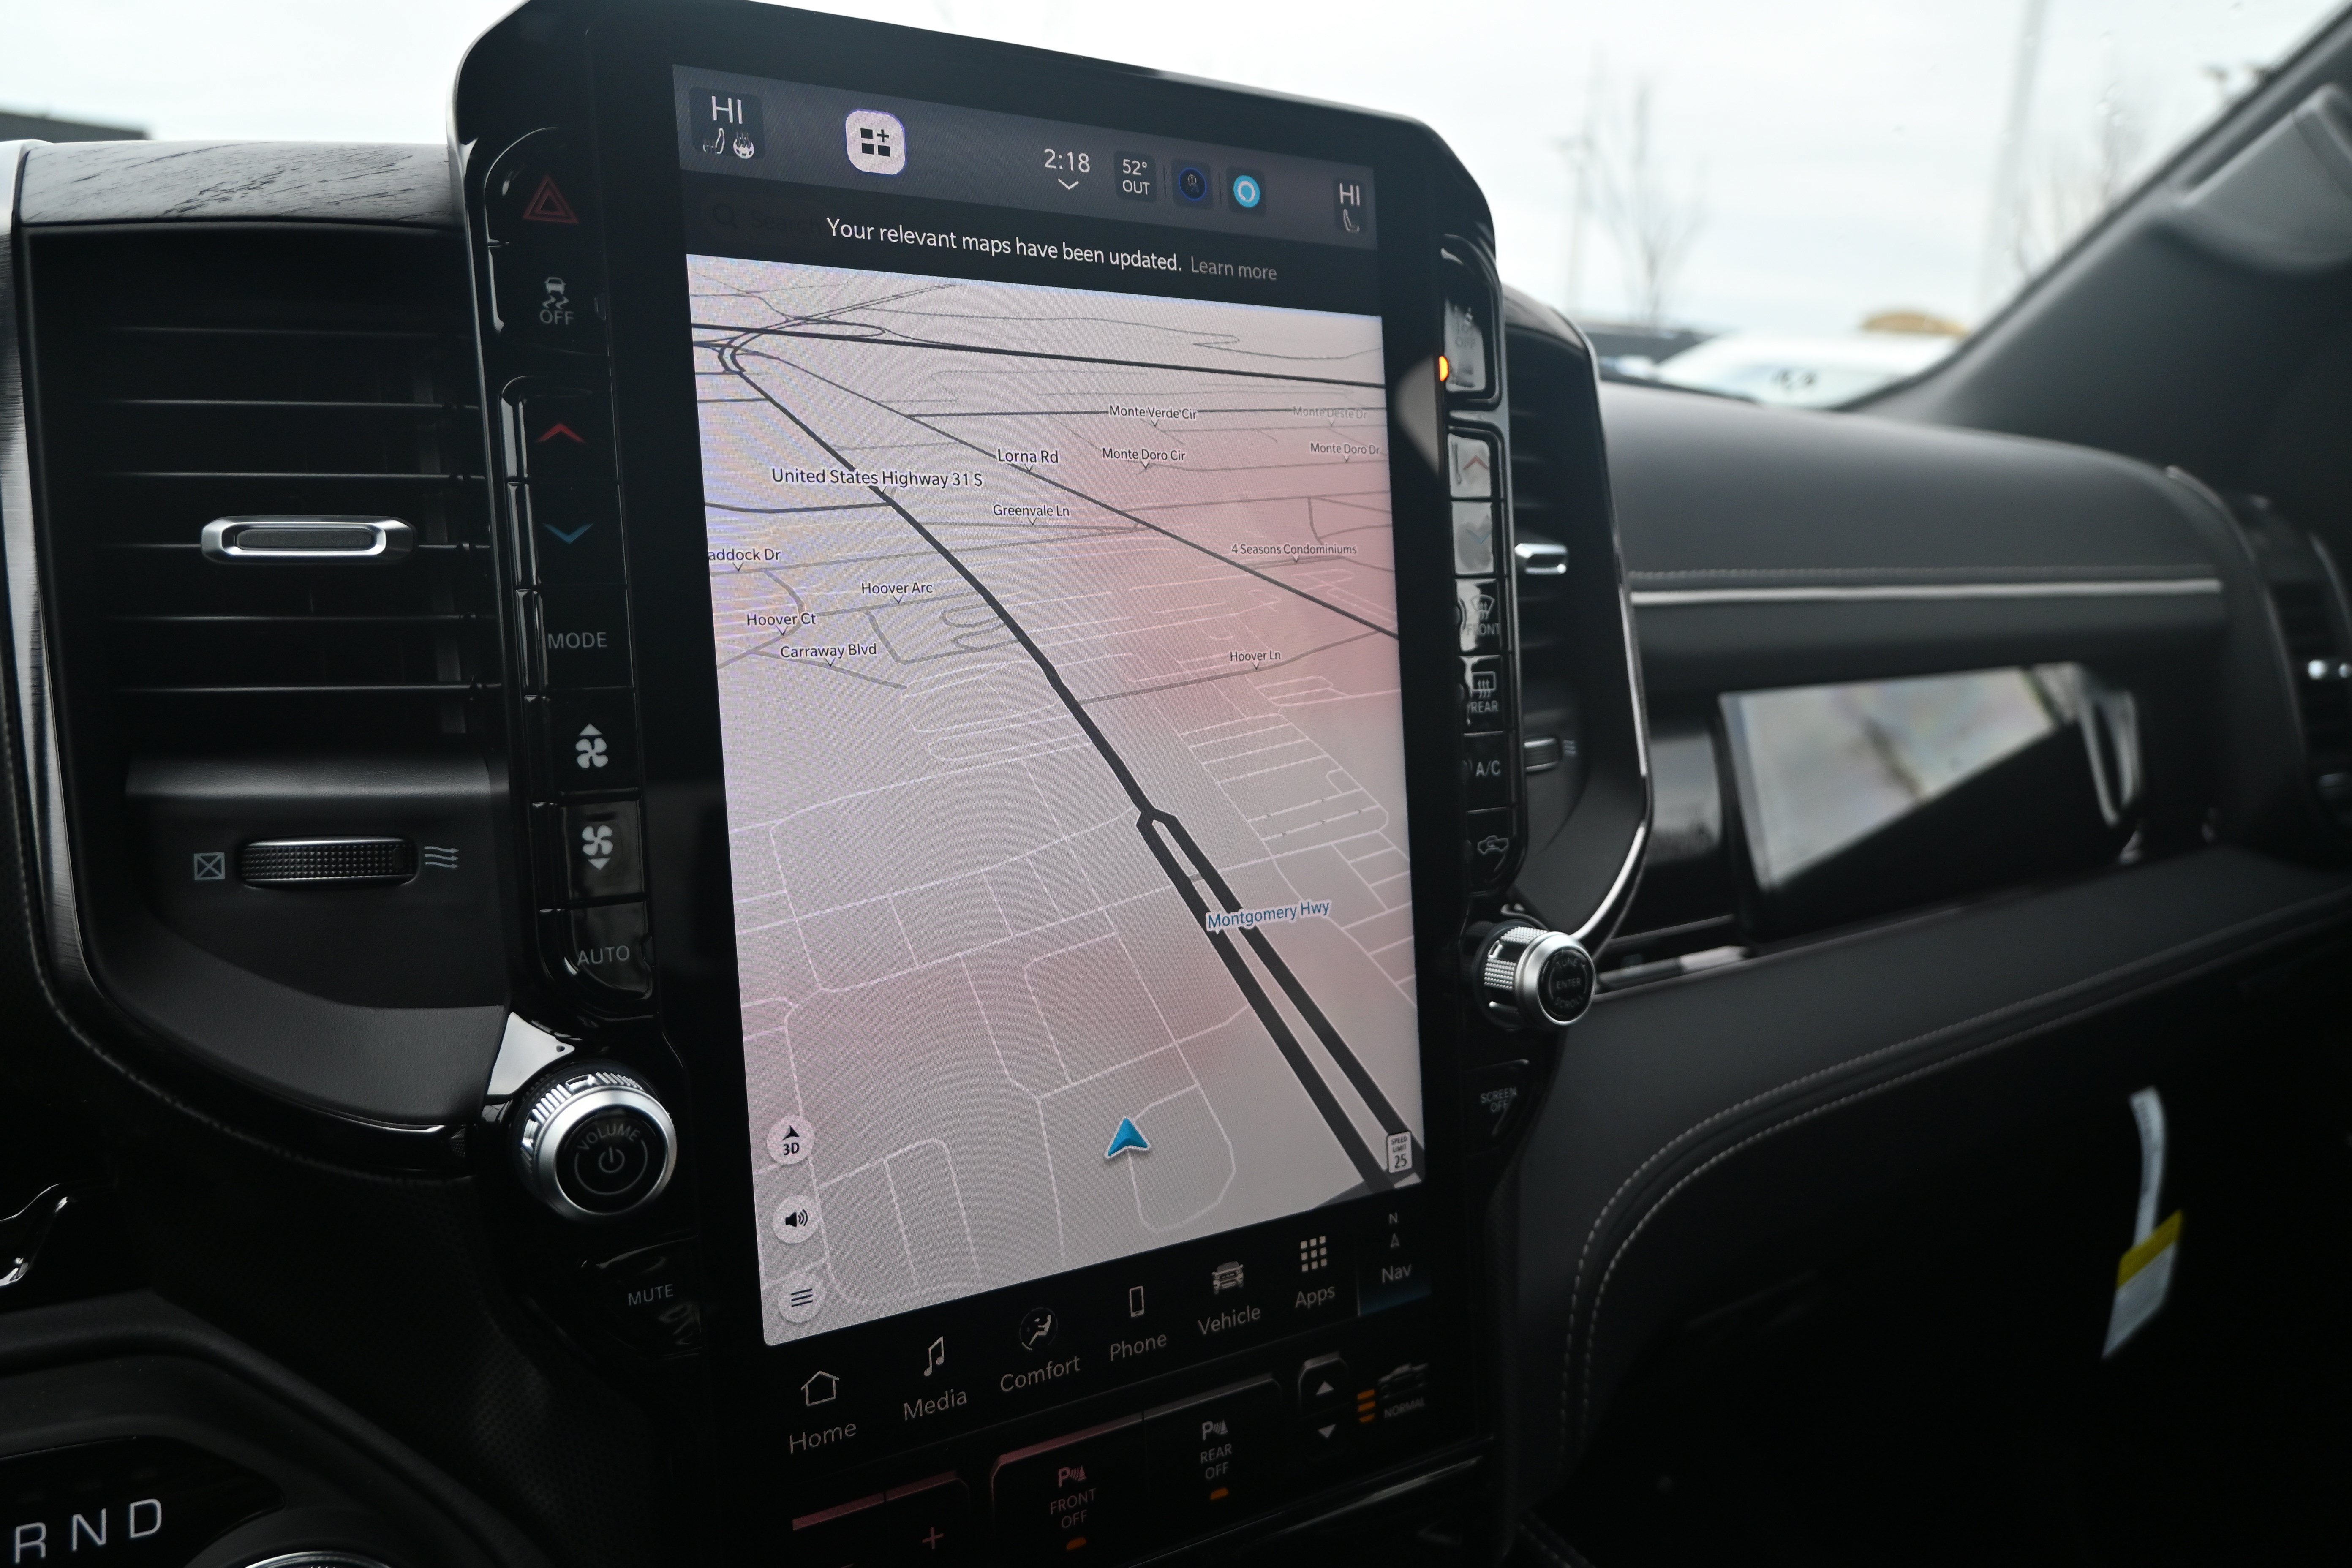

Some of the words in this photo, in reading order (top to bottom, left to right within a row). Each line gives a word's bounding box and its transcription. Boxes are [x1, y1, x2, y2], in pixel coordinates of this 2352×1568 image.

[712, 96, 743, 123] HI
[1044, 148, 1090, 173] 2:18
[1122, 180, 1150, 195] OUT
[1339, 183, 1360, 206] HI
[827, 217, 874, 240] Your
[880, 225, 956, 248] relevant
[962, 237, 1011, 257] maps
[1016, 237, 1057, 259] have
[1063, 242, 1104, 264] been
[1109, 250, 1182, 272] updated.
[1191, 256, 1233, 276] Learn
[1239, 266, 1277, 280] more
[540, 310, 574, 325] OFF
[1110, 405, 1145, 417] Monte
[1148, 407, 1179, 419] Verde
[1182, 408, 1198, 419] Cir
[1293, 406, 1324, 417] Monte
[1356, 409, 1367, 419] Dr
[998, 449, 1037, 463] Lorna
[1041, 450, 1059, 463] Rd
[1102, 448, 1138, 460] Monte
[1142, 449, 1168, 460] Doro
[1170, 450, 1186, 461] Cir
[1311, 442, 1342, 453] Monte
[1344, 444, 1367, 454] Doro
[1369, 445, 1379, 454] Dr
[772, 468, 825, 484] United
[830, 470, 878, 485] States
[882, 471, 948, 488] Highway
[952, 473, 968, 486] 31
[974, 474, 983, 486] S
[993, 505, 1053, 517] Greenvale
[1056, 506, 1069, 517] Ln
[765, 549, 781, 560] Dr
[1231, 544, 1238, 553] 4
[1240, 544, 1281, 554] Seasons
[1283, 544, 1357, 554] Condominiums
[862, 583, 909, 595] Hoover
[912, 583, 933, 594] Arc
[746, 614, 798, 626] Hoover
[801, 613, 816, 625] Ct
[1466, 623, 1500, 636] FRONT
[548, 632, 607, 649] MODE
[780, 645, 845, 659] Carraway
[848, 643, 877, 656] Blvd
[1230, 651, 1267, 662] Hoover
[1269, 650, 1281, 659] Ln
[1470, 700, 1498, 713] REAR
[1476, 760, 1500, 776] A/C
[1208, 906, 1297, 928] Montgomery
[1301, 901, 1329, 916] Hwy
[577, 946, 630, 965] AUTO
[1556, 958, 1578, 969] TUNE
[1557, 978, 1581, 989] ENTER
[1555, 995, 1583, 1008] SCROLL
[1481, 1087, 1517, 1103] SCREEN
[1491, 1101, 1508, 1112] OFF
[577, 1123, 641, 1151] VOLUME
[1391, 1136, 1407, 1145] SPEED
[783, 1142, 800, 1155] 3D
[1393, 1144, 1406, 1153] LIMIT
[1394, 1154, 1407, 1168] 25
[1389, 1212, 1398, 1225] N
[1382, 1264, 1411, 1283] Nav
[628, 1284, 674, 1307] MUTE
[1295, 1285, 1336, 1309] Apps
[1198, 1305, 1261, 1335] Vehicle
[1110, 1334, 1167, 1361] Phone
[1000, 1355, 1081, 1392] Comfort
[904, 1389, 968, 1421] Media
[1384, 1397, 1425, 1419] NORMAL
[789, 1423, 857, 1454] Home
[1200, 1444, 1232, 1464] REAR
[1205, 1462, 1229, 1480] OFF
[1050, 1488, 1096, 1515] FRONT
[1061, 1509, 1088, 1529] OFF
[14, 1522, 47, 1564] R
[72, 1508, 106, 1552] N
[129, 1498, 162, 1540] D
